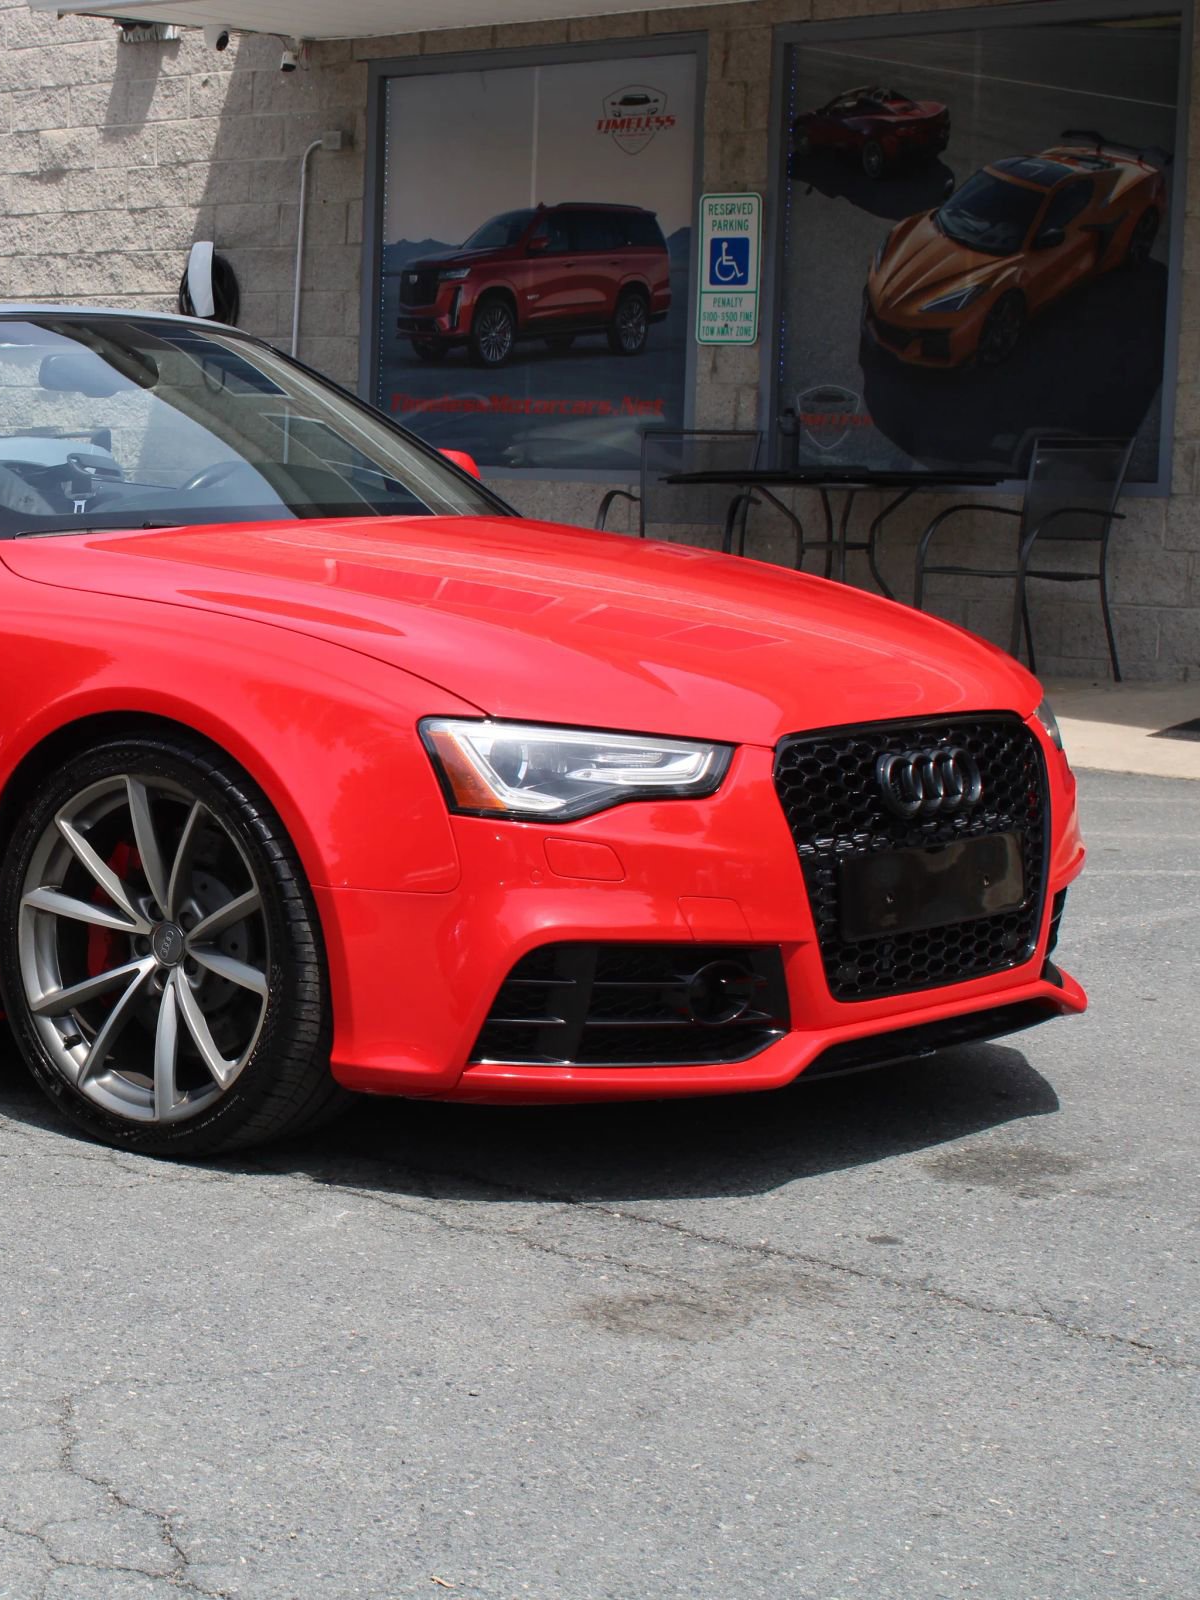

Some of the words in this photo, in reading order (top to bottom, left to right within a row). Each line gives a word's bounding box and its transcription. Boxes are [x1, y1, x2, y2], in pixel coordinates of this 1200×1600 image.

[596, 116, 676, 131] TIMELESS
[708, 203, 753, 216] RESERVED
[711, 219, 749, 232] PARKING
[712, 296, 743, 308] PENALTY
[739, 311, 753, 322] FINE
[702, 326, 715, 337] TOW
[716, 326, 734, 337] AWAY
[735, 325, 753, 337] ZONE
